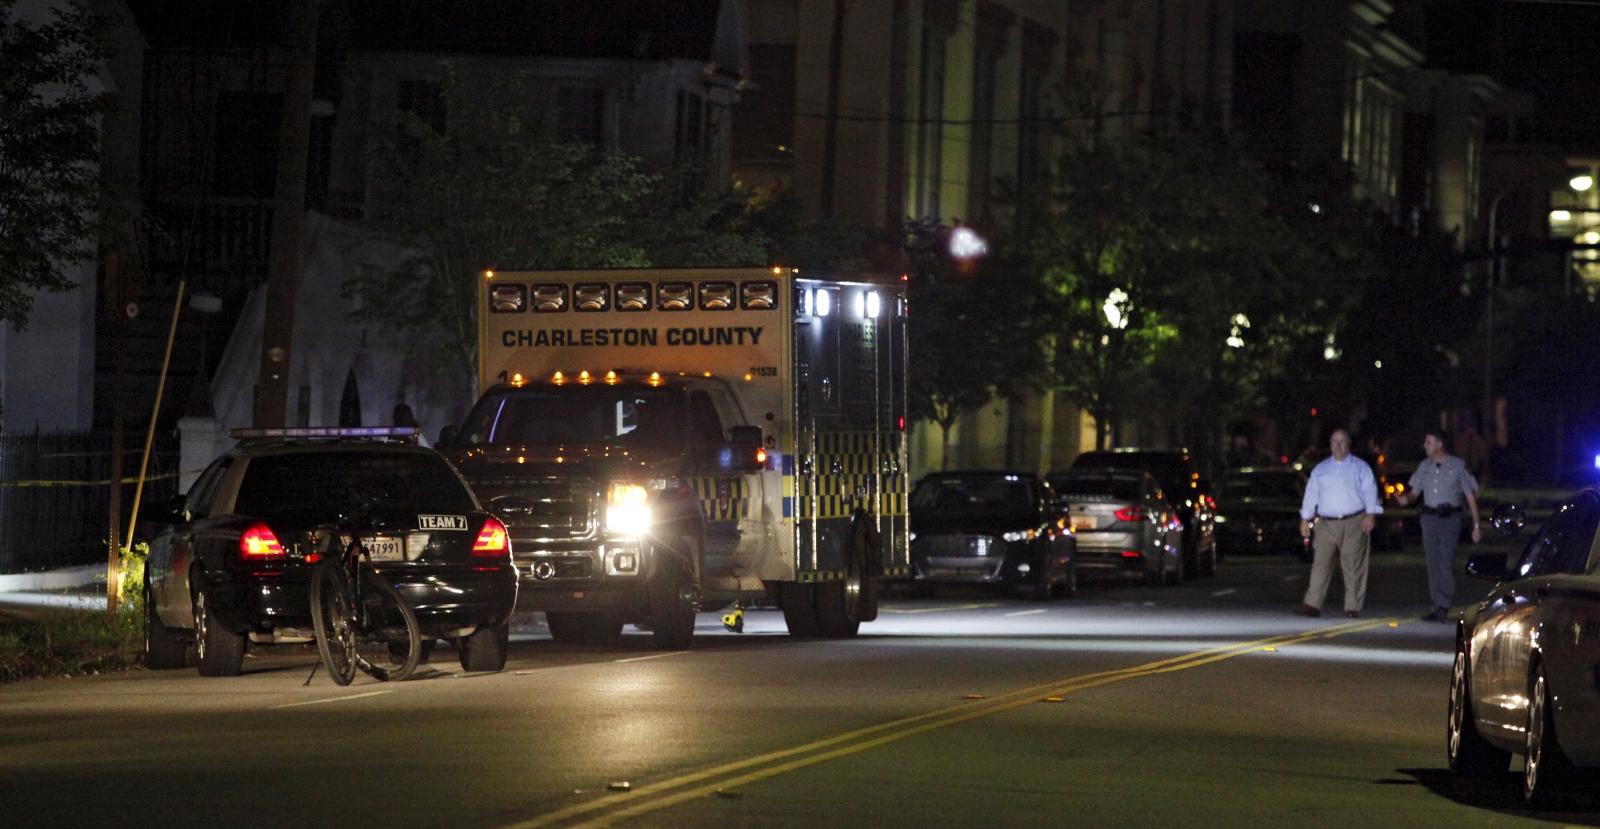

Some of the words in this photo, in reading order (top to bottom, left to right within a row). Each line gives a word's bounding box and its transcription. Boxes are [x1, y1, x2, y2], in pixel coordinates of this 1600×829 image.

[502, 329, 657, 346] CHARLESTON
[666, 327, 763, 345] COUNTY
[420, 516, 455, 528] TEAM
[456, 517, 464, 528] 7
